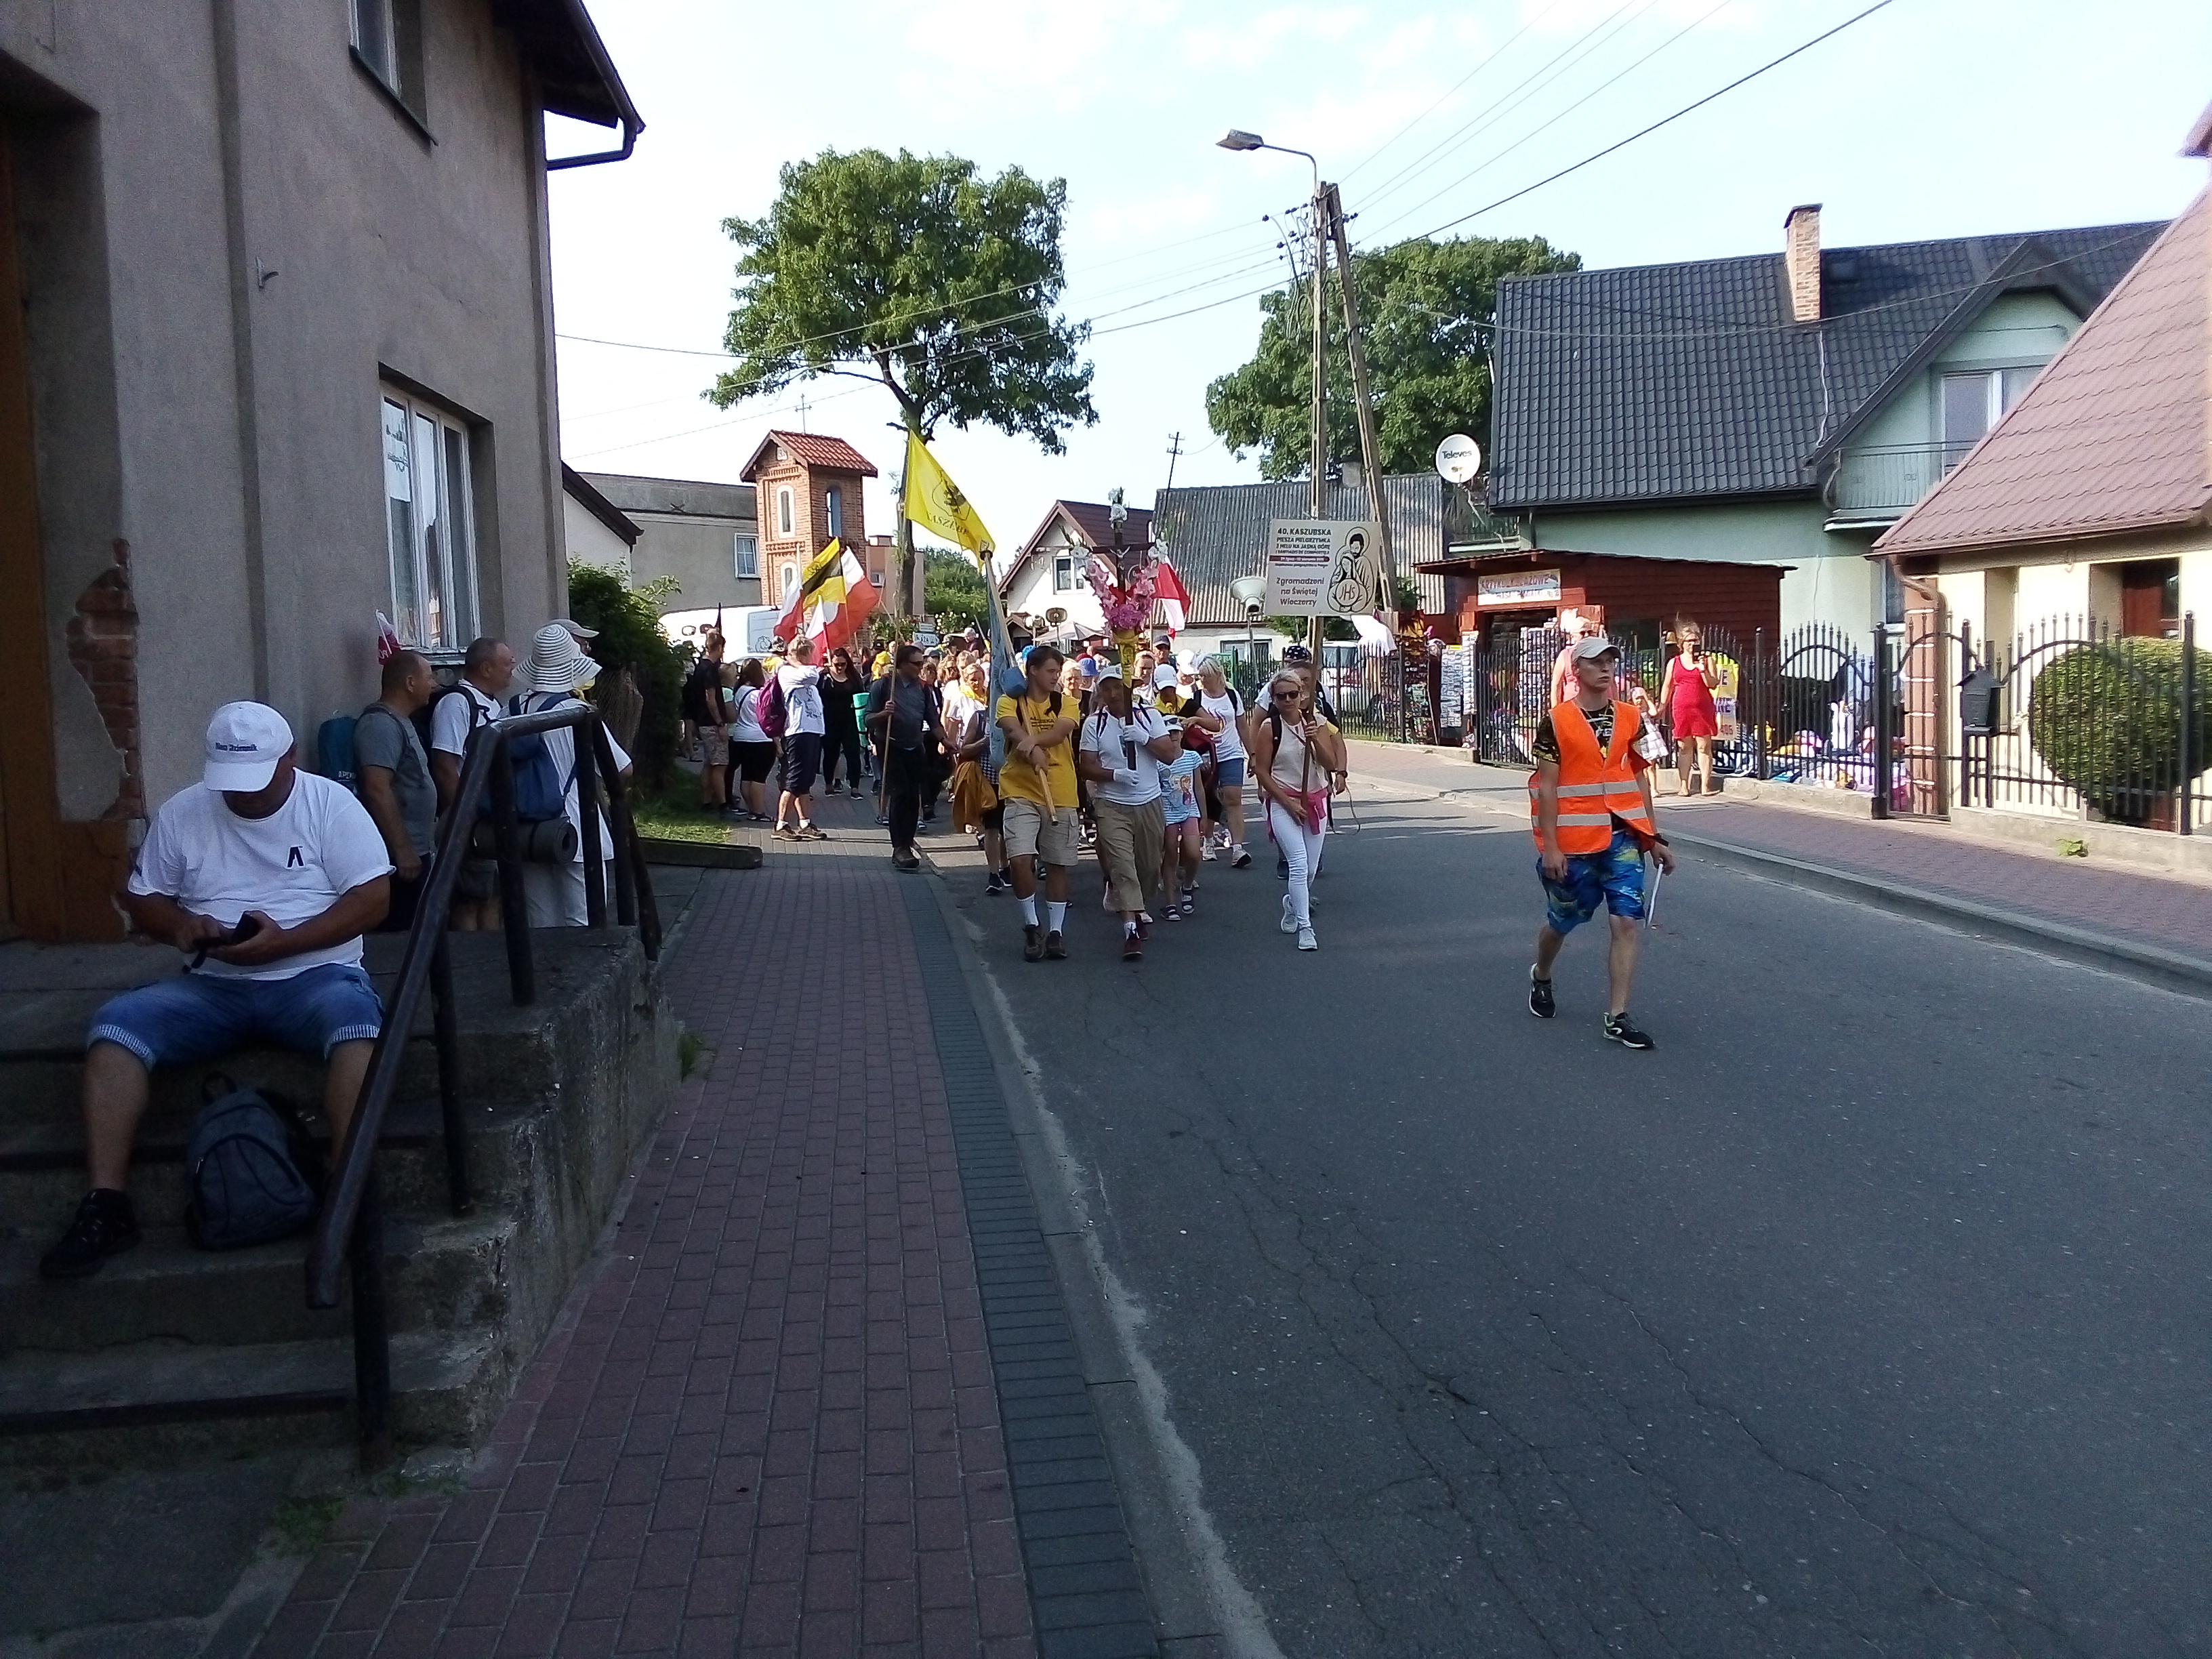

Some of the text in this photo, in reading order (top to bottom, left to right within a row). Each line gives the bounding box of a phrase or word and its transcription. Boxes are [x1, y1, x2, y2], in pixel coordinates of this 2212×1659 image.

[1441, 450, 1472, 459] Televes
[1276, 577, 1325, 586] Zgromadzeni
[1292, 586, 1318, 596] Świętej
[1279, 598, 1317, 607] Wieczerzy
